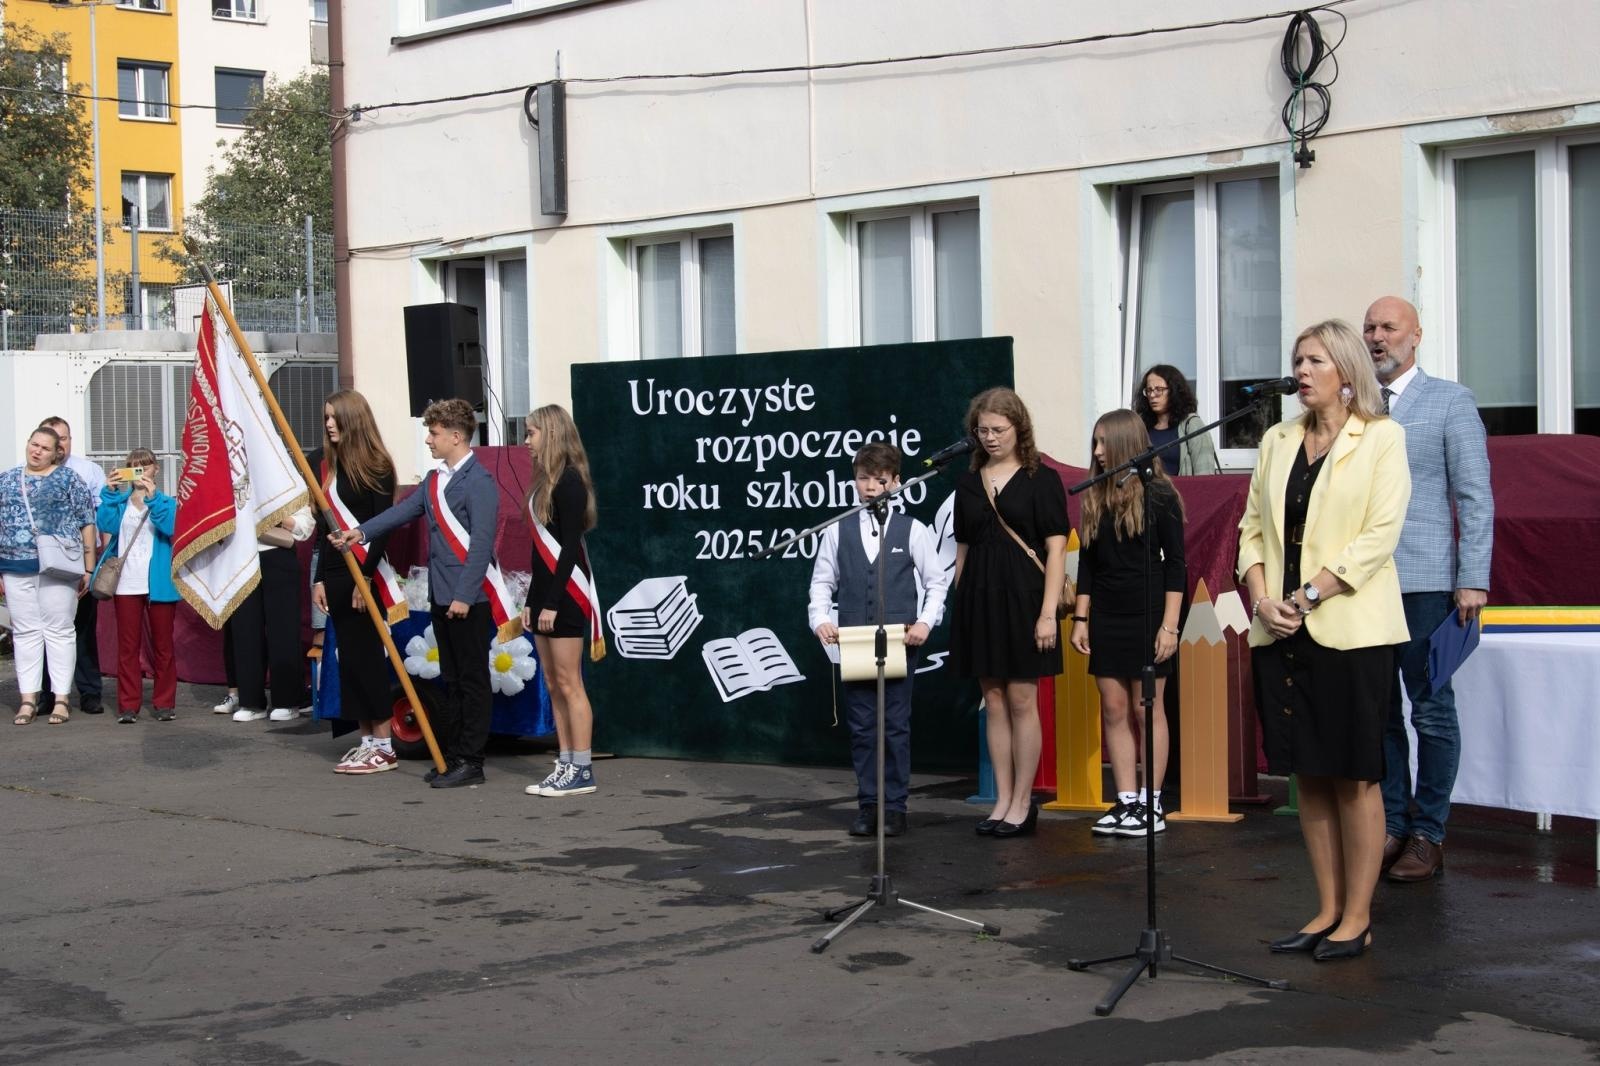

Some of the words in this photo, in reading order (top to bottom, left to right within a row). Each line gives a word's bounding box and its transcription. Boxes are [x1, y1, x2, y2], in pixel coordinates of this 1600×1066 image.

[628, 377, 816, 428] Uroczyste
[642, 474, 721, 511] roku
[746, 470, 927, 515] szkolngo
[694, 527, 828, 560] 2025/20
